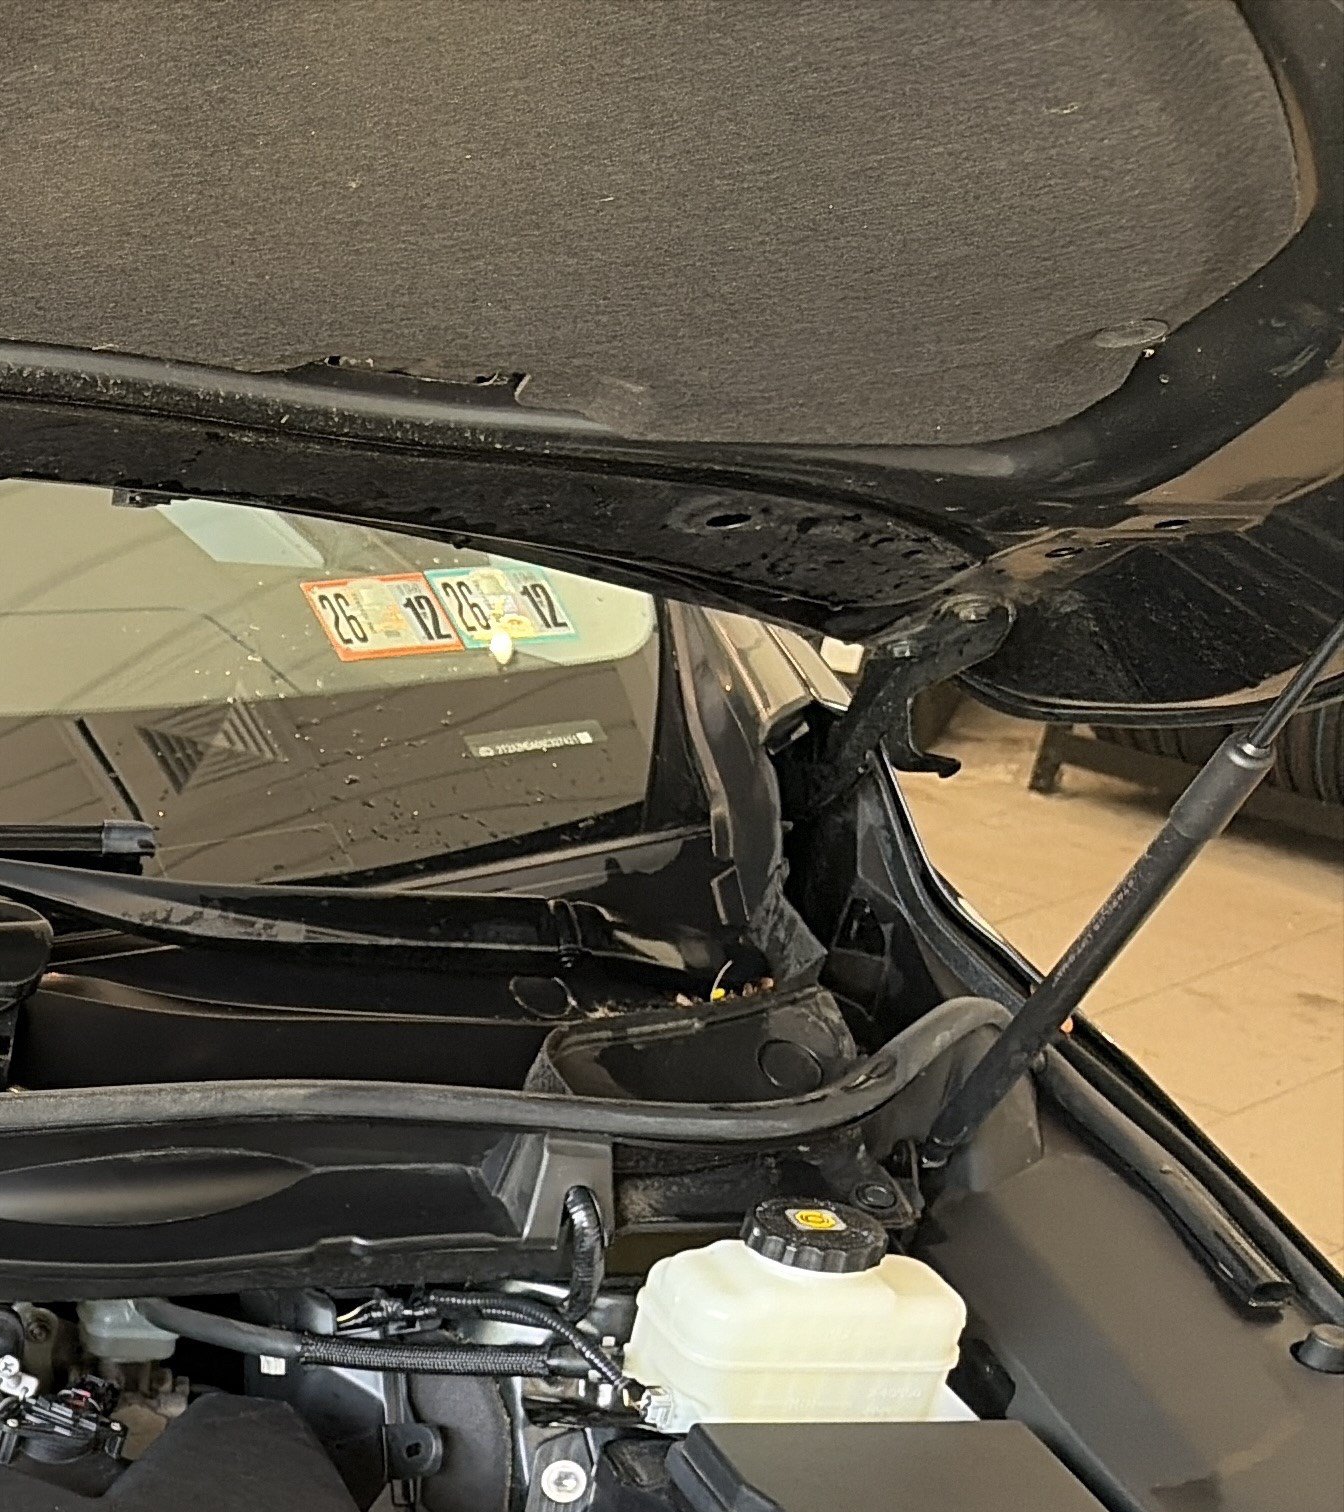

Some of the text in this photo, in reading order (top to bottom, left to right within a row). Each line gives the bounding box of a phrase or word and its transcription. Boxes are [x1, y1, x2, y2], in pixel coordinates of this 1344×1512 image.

[319, 593, 453, 645] 26 12
[442, 580, 568, 632] 26 12
